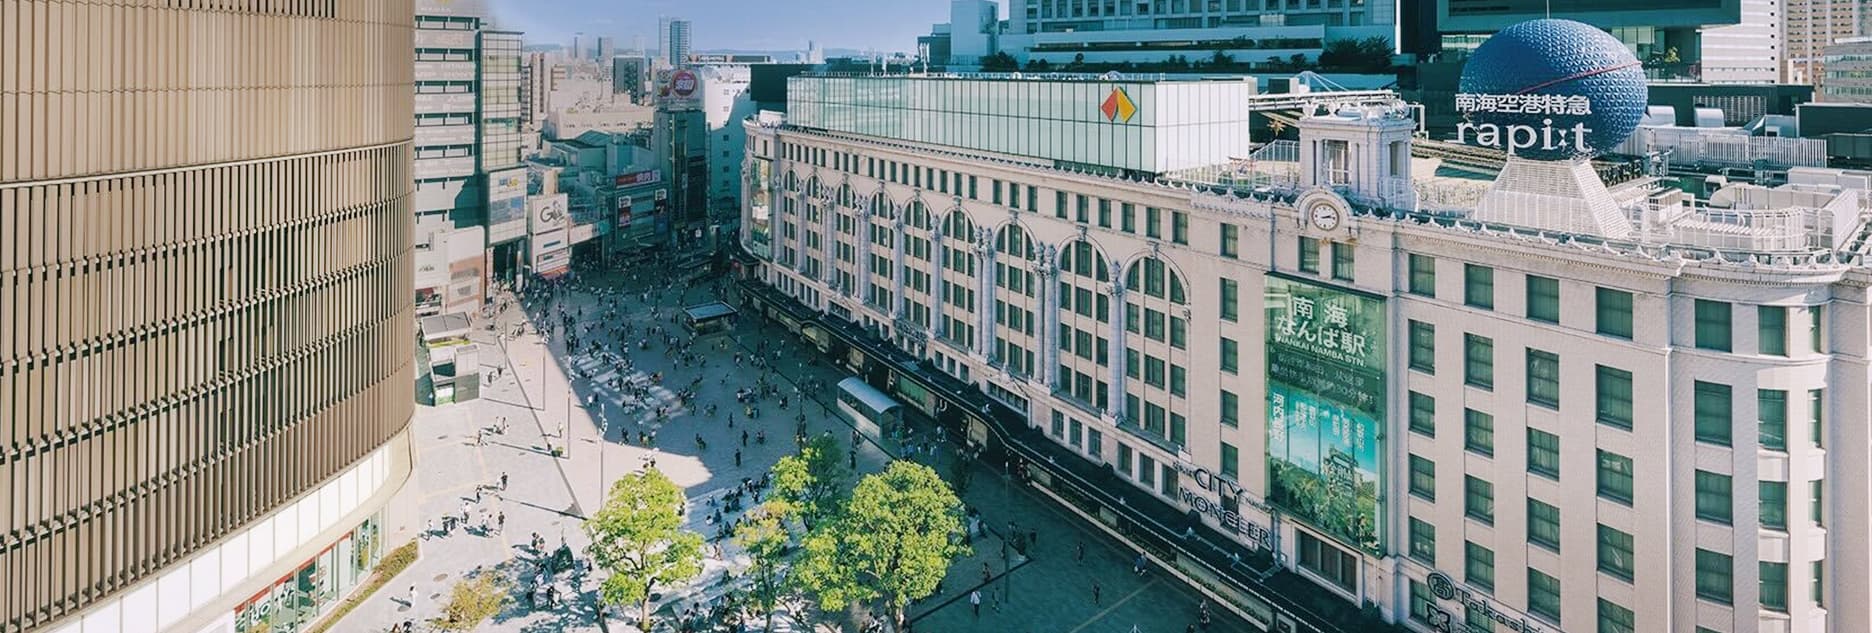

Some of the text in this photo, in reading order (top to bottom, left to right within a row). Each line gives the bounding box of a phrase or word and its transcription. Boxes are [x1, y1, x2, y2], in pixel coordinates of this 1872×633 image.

[1455, 93, 1592, 115] 南海空港特急
[1275, 314, 1366, 357] なんば駅
[1311, 344, 1344, 361] NAMBA
[1194, 468, 1243, 505] CITY
[1178, 487, 1272, 551] MONCLER
